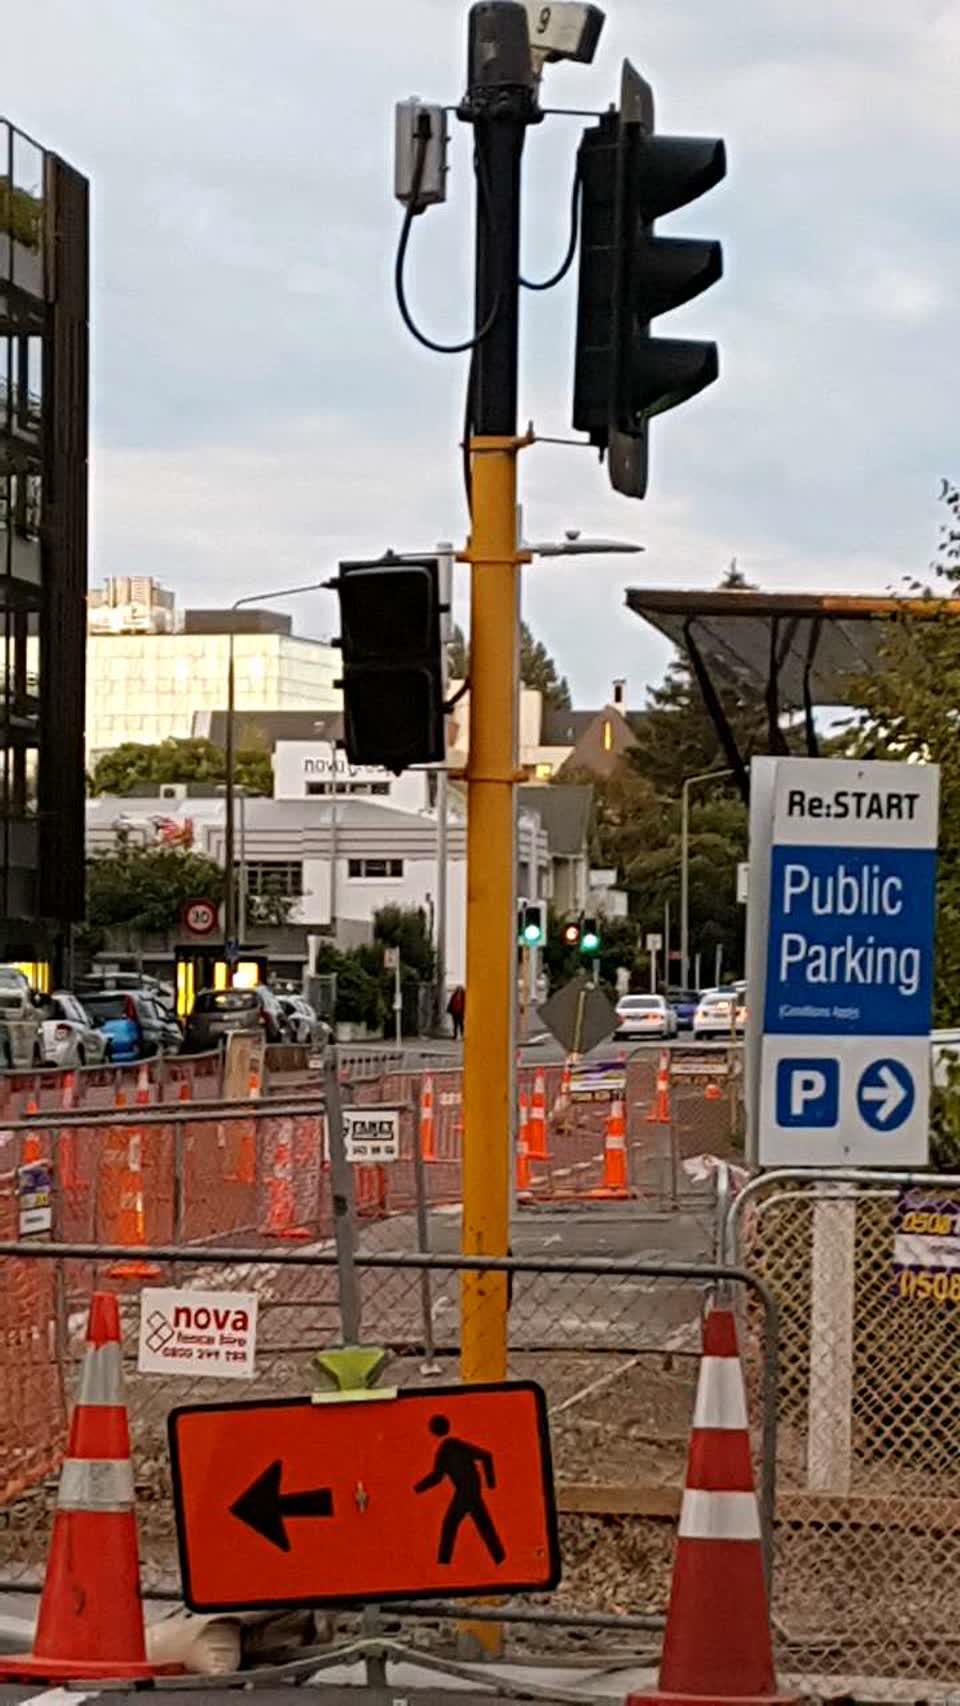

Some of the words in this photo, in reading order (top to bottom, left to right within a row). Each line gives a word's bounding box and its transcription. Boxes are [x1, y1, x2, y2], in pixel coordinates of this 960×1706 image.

[537, 6, 551, 34] 9
[788, 789, 920, 820] Re:START
[783, 864, 903, 916] Public
[779, 933, 921, 996] Parking
[790, 1069, 827, 1115] P
[174, 1306, 249, 1331] nova
